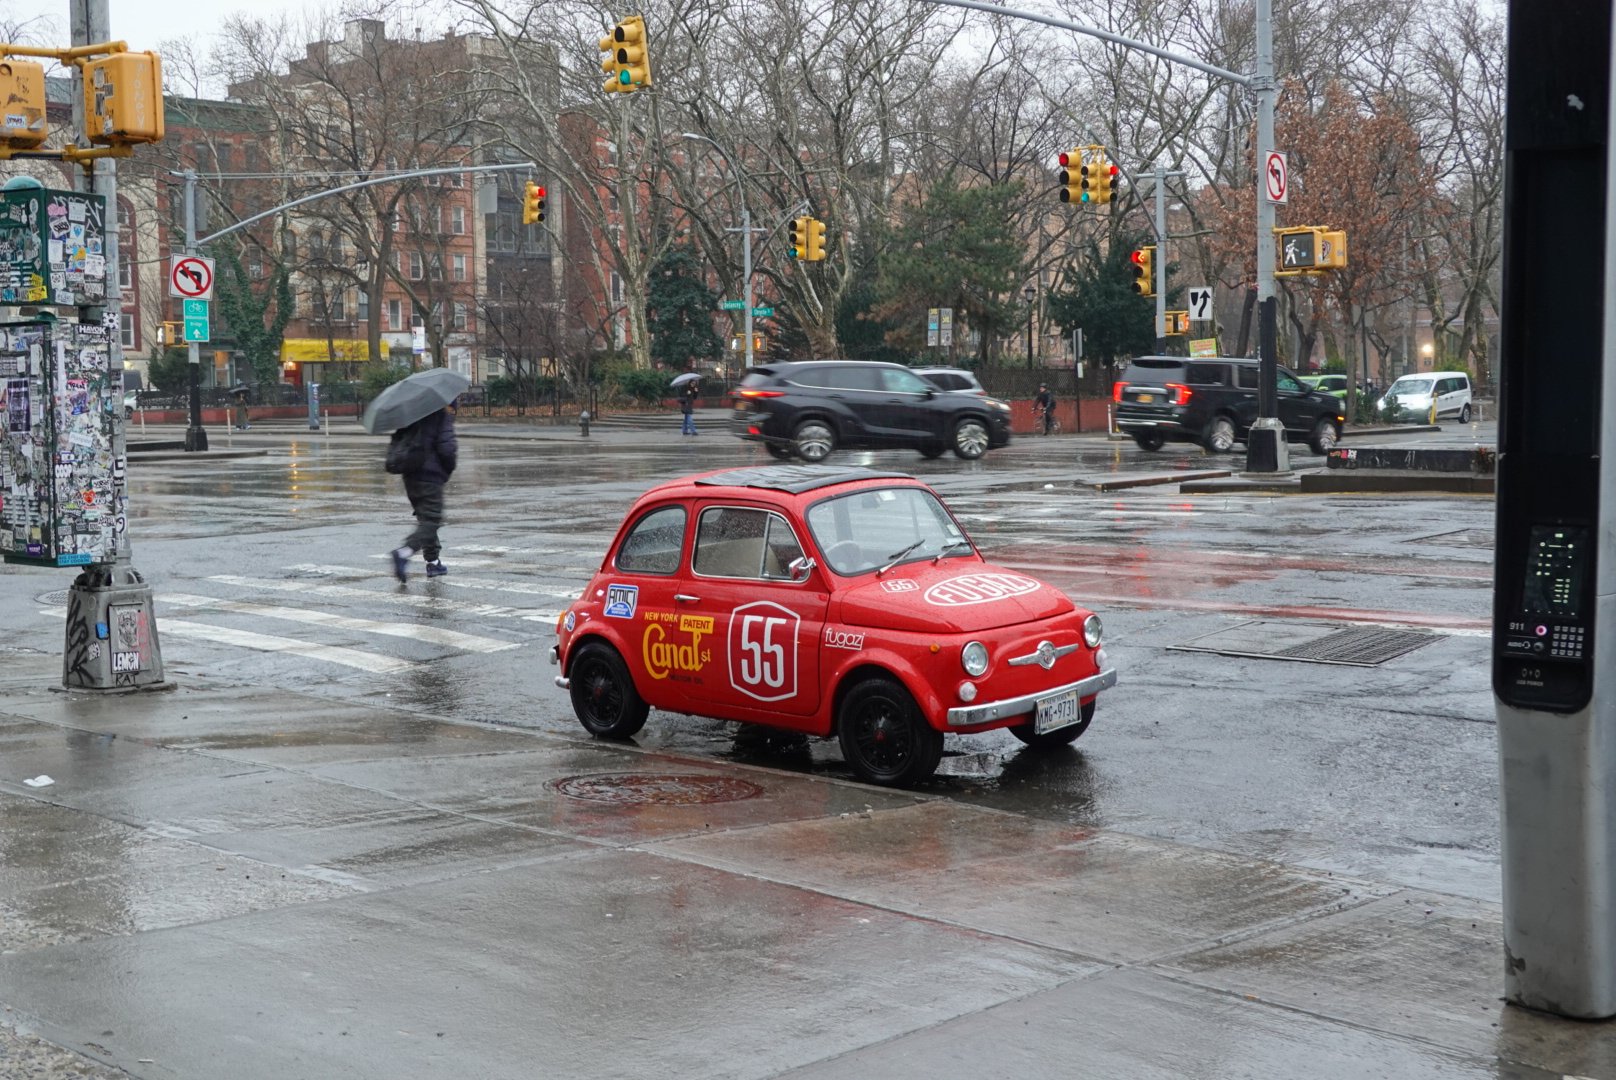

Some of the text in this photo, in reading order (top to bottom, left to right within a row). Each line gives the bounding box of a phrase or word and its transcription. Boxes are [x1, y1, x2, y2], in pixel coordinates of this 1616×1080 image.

[79, 325, 107, 334] HAVOK
[888, 579, 914, 592] 55
[931, 574, 1036, 603] FUGAZI
[644, 611, 679, 622] NEW YORK
[683, 618, 712, 630] PATENT
[1509, 622, 1525, 631] 911
[825, 627, 866, 649] fugazi
[643, 623, 703, 680] Canal
[741, 615, 787, 688] 55
[113, 652, 139, 671] LEMON
